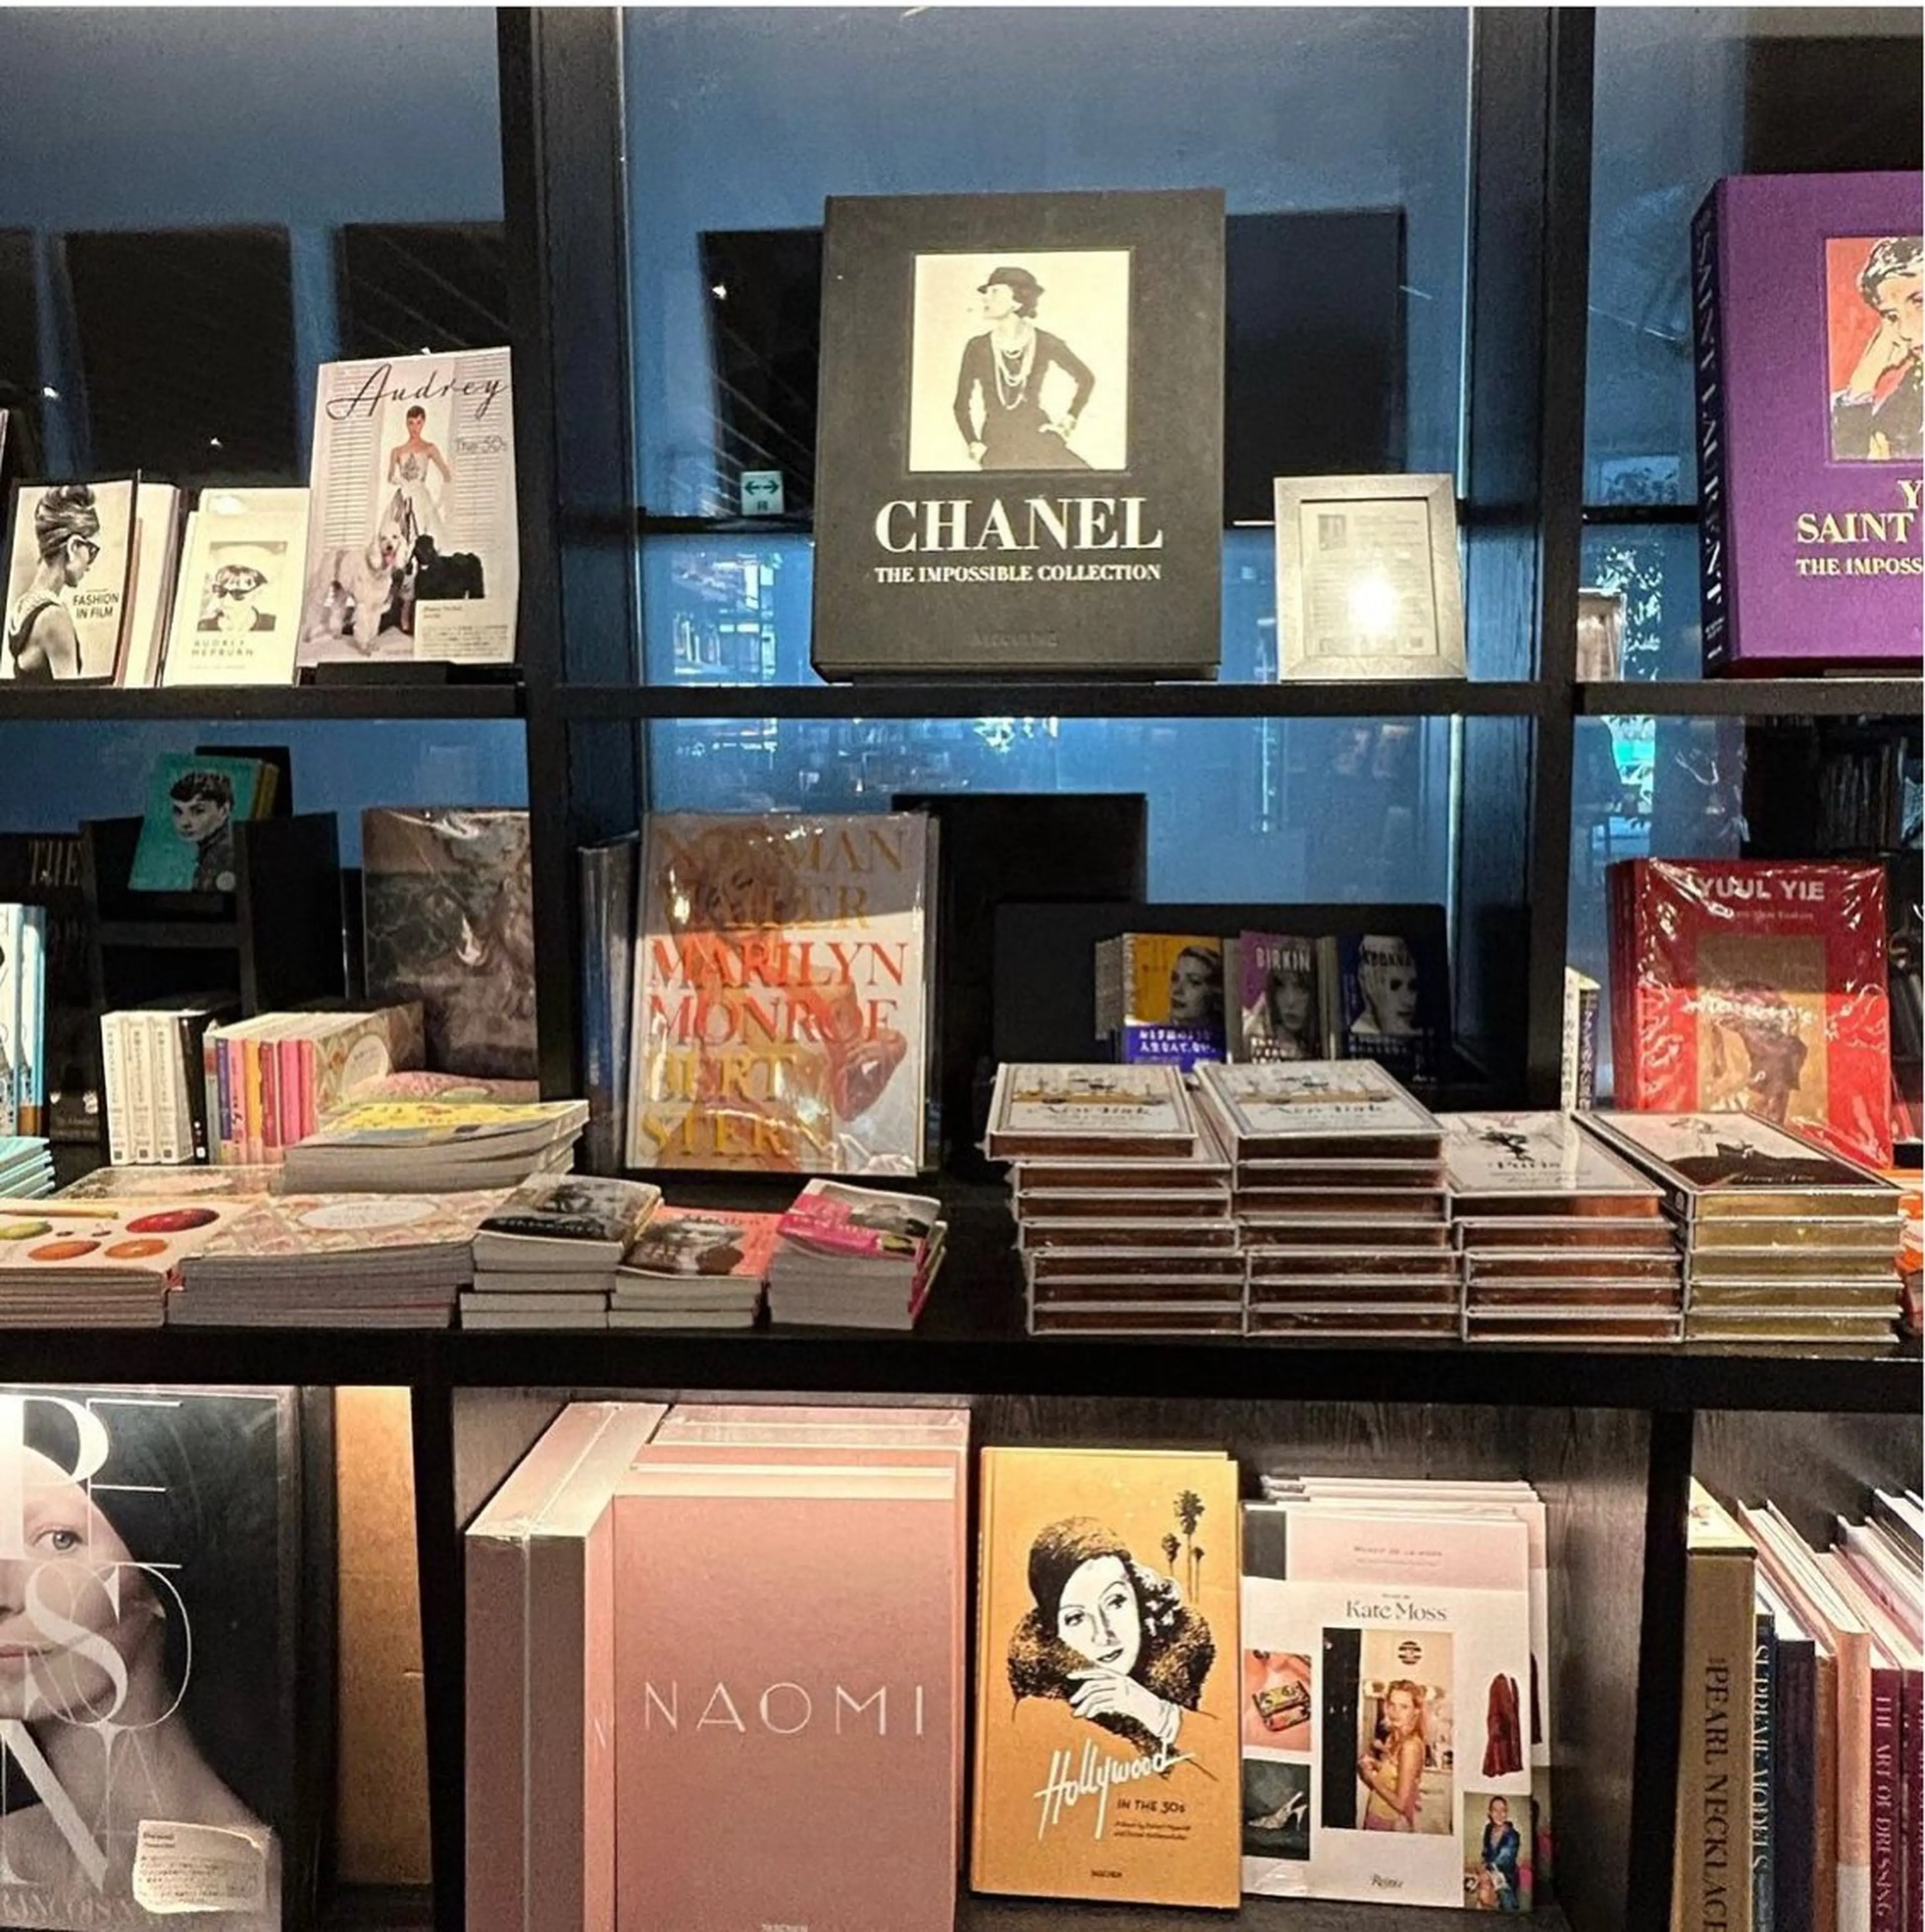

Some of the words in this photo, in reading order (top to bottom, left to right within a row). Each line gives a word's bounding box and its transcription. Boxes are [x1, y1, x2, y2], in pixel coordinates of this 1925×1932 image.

[326, 363, 511, 420] Audrey
[874, 497, 1164, 553] CHANEL
[1796, 512, 1914, 544] SAINT
[874, 566, 915, 583] THE
[918, 565, 1034, 583] IMPOSSIBLE
[1037, 564, 1162, 582] COLLECTION
[1796, 558, 1840, 575] THE
[73, 592, 119, 606] FASHION
[76, 608, 88, 620] IN
[90, 606, 114, 619] FILM
[1779, 879, 1826, 901] YIE
[649, 939, 908, 989] MARILYN
[648, 996, 900, 1046] MONROE
[1346, 1600, 1392, 1619] Kate
[1395, 1602, 1447, 1621] Moss
[644, 1681, 923, 1735] NAOMI
[1705, 1666, 1729, 1766] PEARL
[1753, 1644, 1770, 1760] SUPREME
[1875, 1696, 1892, 1729] THE
[1875, 1743, 1892, 1780] ART
[1034, 1737, 1197, 1841] Hollywood
[1116, 1798, 1131, 1810] IN
[1134, 1799, 1158, 1812] THE
[1752, 1768, 1770, 1874] MODELS
[1875, 1817, 1892, 1917] DRESSING
